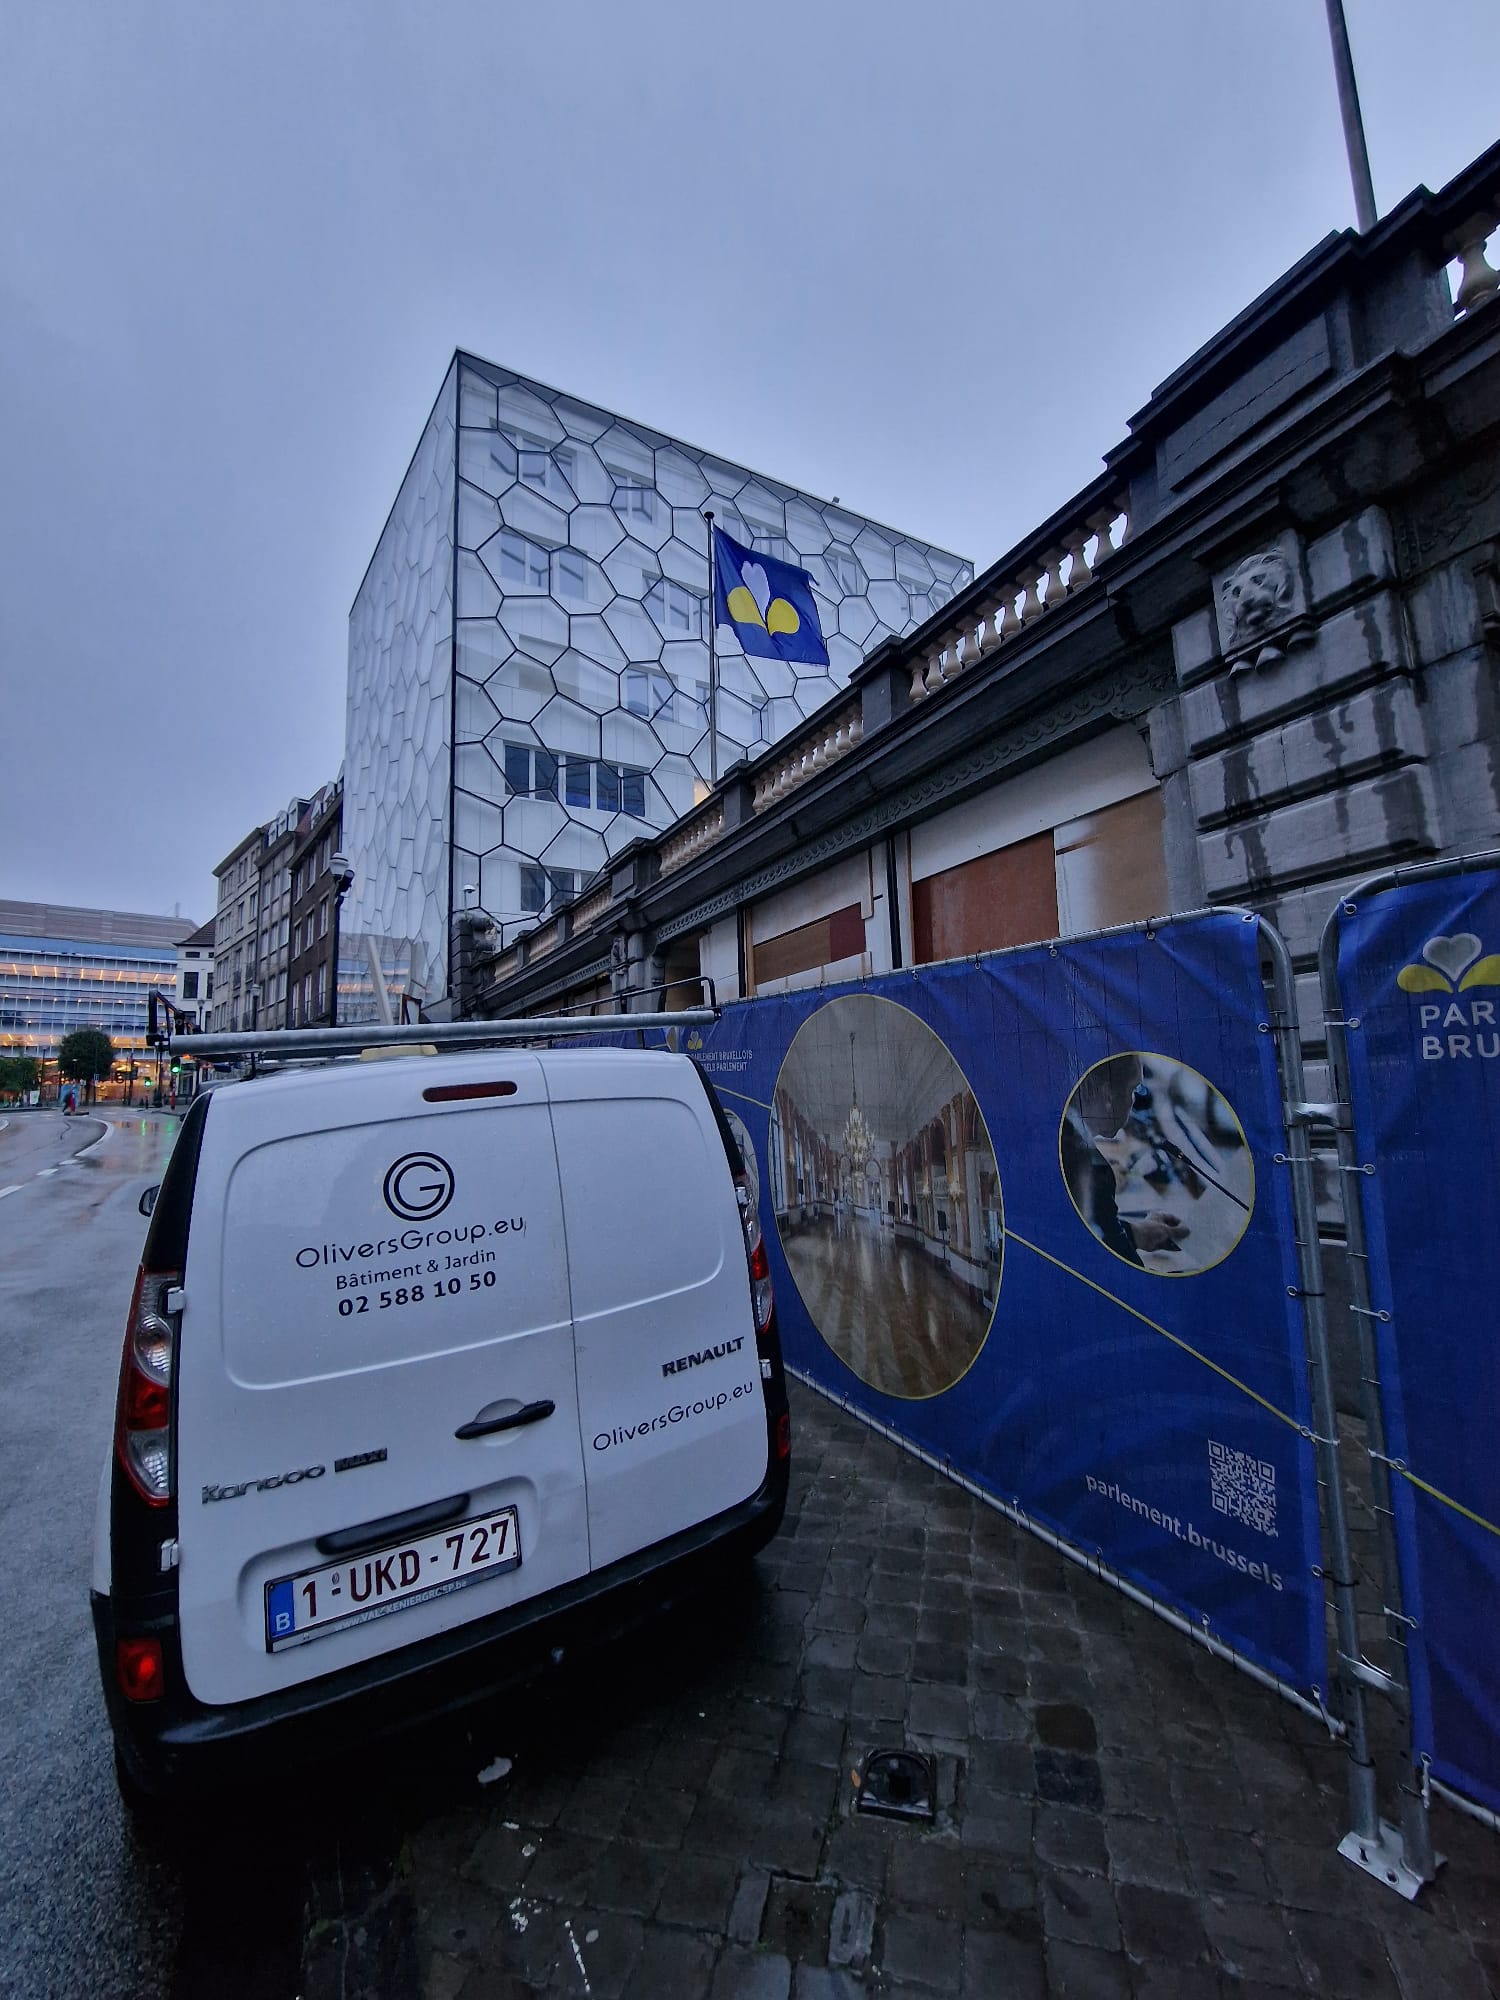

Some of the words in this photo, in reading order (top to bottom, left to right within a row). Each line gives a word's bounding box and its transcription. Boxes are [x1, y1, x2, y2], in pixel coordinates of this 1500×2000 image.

[1420, 1001, 1497, 1029] PAR
[717, 1062, 748, 1072] PARLEMENT
[720, 1050, 753, 1060] BRUXELLOIS
[1422, 1033, 1500, 1060] BRU
[296, 1217, 524, 1268] OliversGroup.eu
[336, 1263, 422, 1290] Bâtiment
[427, 1259, 439, 1273] &
[444, 1250, 496, 1270] Jardin
[338, 1295, 370, 1317] 02
[379, 1285, 425, 1309] 588
[433, 1278, 461, 1298] 10
[469, 1271, 497, 1291] 50
[661, 1336, 745, 1378] RENAULT
[593, 1381, 753, 1451] OliversGroup.eu
[1086, 1475, 1284, 1592] parlement.brussels
[302, 1518, 509, 1618] 1-UKD-727
[275, 1612, 291, 1632] B
